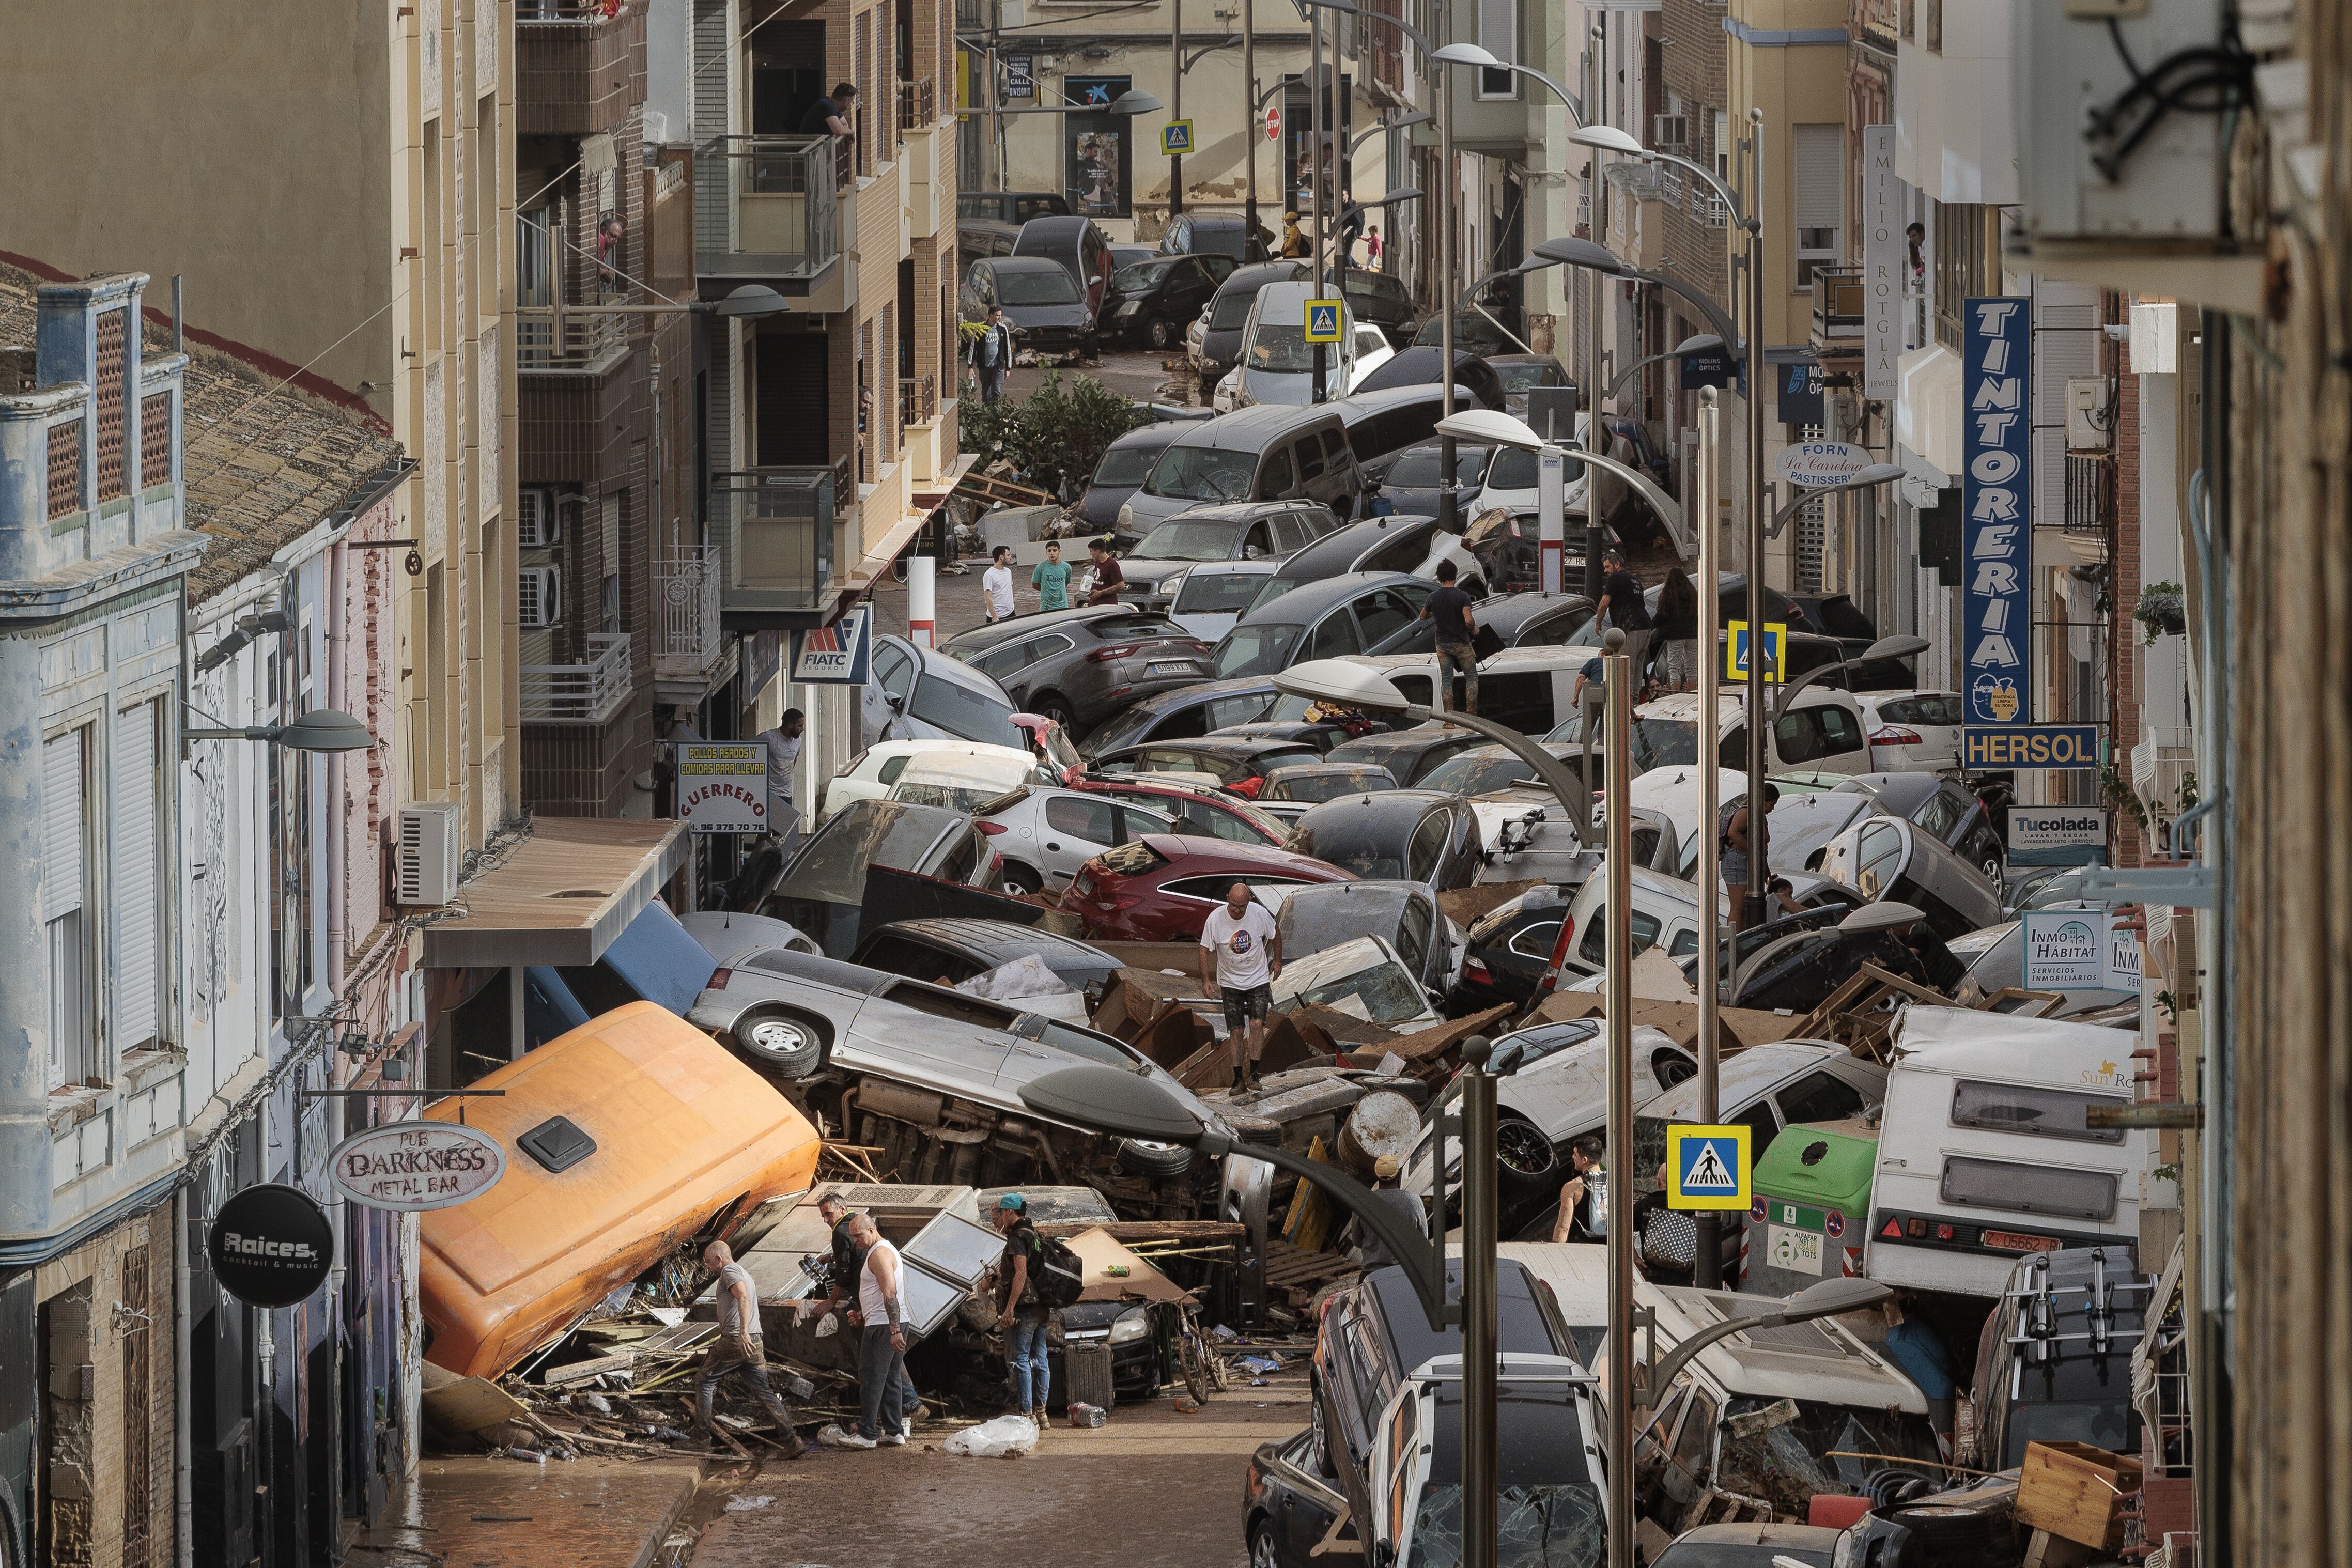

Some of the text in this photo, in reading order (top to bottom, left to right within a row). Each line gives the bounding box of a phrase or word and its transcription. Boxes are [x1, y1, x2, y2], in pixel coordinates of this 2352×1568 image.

[1267, 119, 1279, 129] STOP
[1875, 137, 1890, 370] EMILIO ROTGLÁ
[1809, 366, 1824, 378] MO
[1809, 380, 1823, 394] ÒP
[1802, 444, 1848, 456] FORN
[1783, 455, 1863, 472] La Carretera
[1790, 471, 1855, 485] PASTISSERI
[1971, 302, 2020, 669] TINTORERIA
[804, 654, 846, 665] FIATC
[689, 747, 757, 759] POLLOS ASADOS Y
[1969, 734, 2093, 763] HERSOL
[680, 763, 765, 775] COMIDAS PARA LLEVAR
[680, 783, 765, 817] GUERRERO
[2015, 817, 2099, 831] Tucolada
[1233, 935, 1248, 943] XXVI
[2113, 941, 2139, 970] INM
[2127, 976, 2141, 988] SER
[2080, 1070, 2134, 1089] Sun Ro
[400, 1131, 429, 1149] PUB
[347, 1147, 486, 1177] DARKNESS
[371, 1176, 460, 1196] METAL BAR
[1794, 1232, 1817, 1241] ALFAFAR
[2003, 1235, 2040, 1251] 05662
[224, 1232, 310, 1258] Raices
[223, 1255, 267, 1266] cocktail
[1801, 1249, 1817, 1259] TOTS
